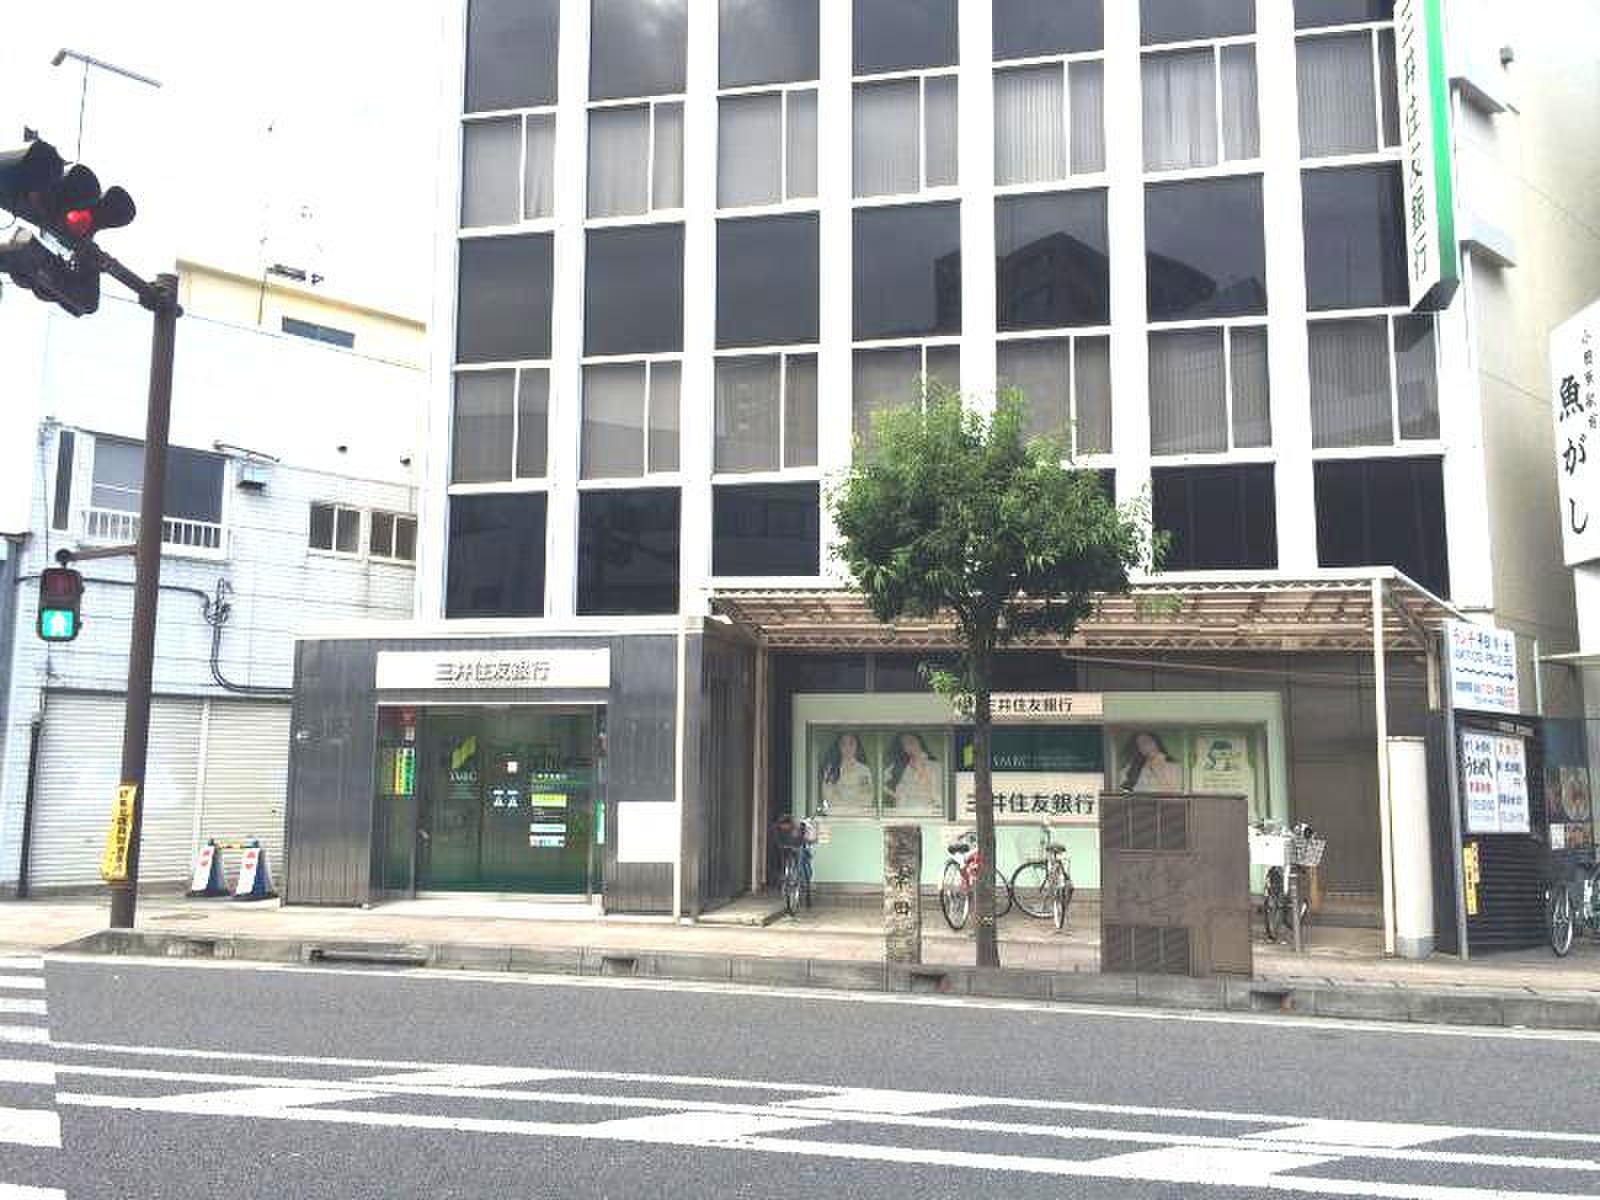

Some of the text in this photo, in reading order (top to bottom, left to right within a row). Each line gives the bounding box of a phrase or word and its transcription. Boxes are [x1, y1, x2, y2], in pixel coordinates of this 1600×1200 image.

[1559, 374, 1589, 535] 魚がし
[434, 660, 550, 682] 三井住友銀行
